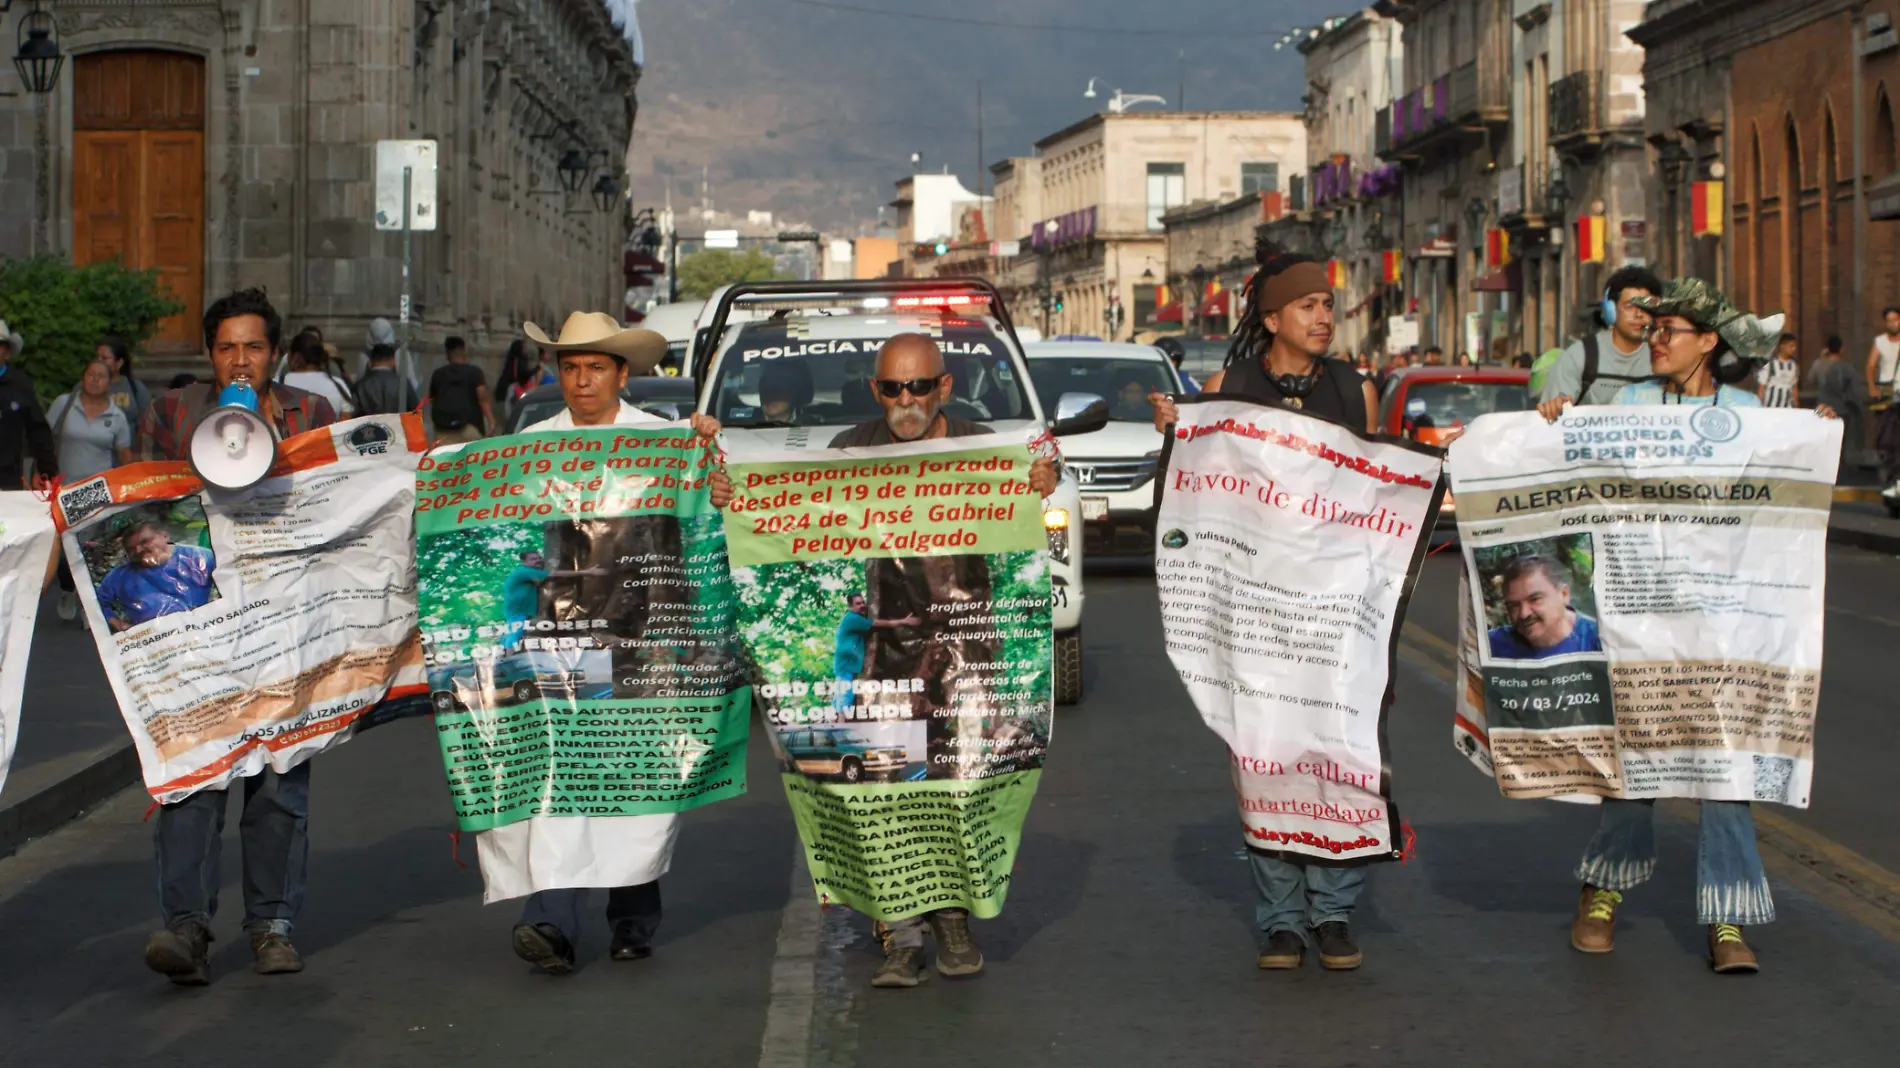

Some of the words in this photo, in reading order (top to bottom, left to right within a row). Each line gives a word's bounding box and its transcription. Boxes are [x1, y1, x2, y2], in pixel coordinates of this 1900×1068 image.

[743, 340, 857, 362] POLICÍA
[863, 341, 992, 355] MELIA
[1561, 412, 1654, 429] COMISIÓN
[1659, 415, 1683, 426] DE
[1563, 428, 1683, 446] BÚSQUEDA
[360, 446, 387, 456] FGE
[418, 437, 601, 472] Desaparición
[611, 435, 711, 453] forzada
[1565, 448, 1593, 462] DE
[1597, 444, 1714, 460] PERSONAS
[415, 469, 472, 493] esde
[482, 463, 508, 481] el
[519, 459, 552, 475] 19
[560, 456, 596, 473] de
[606, 456, 688, 471] marzo
[746, 461, 910, 488] Desaparición
[916, 456, 1014, 478] forzada
[416, 487, 481, 512] 2024
[490, 481, 526, 499] de
[539, 474, 603, 497] José
[730, 489, 808, 513] desde
[810, 484, 832, 506] el
[841, 483, 869, 502] 19
[876, 479, 906, 499] de
[914, 480, 991, 497] marzo
[1495, 484, 1593, 514] ALERTA
[1600, 483, 1634, 499] DE
[1641, 481, 1773, 501] BÚSQUEDA
[1174, 468, 1250, 494] Favor
[1257, 480, 1290, 509] de
[1301, 492, 1412, 538] difundir
[456, 500, 553, 524] Pelayo
[752, 512, 811, 535] 2024
[818, 509, 848, 529] de
[859, 504, 914, 530] José
[928, 502, 1015, 523] Gabriel
[1561, 513, 1589, 527] JOSÉ
[1591, 513, 1642, 524] GABRIEL
[1644, 513, 1688, 525] PELAYO
[1690, 515, 1742, 526] ZALGADO
[791, 533, 873, 555] Pelayo
[879, 528, 979, 553] Zalgado
[1195, 531, 1230, 545] Yulissa
[1230, 538, 1258, 556] Pelayo
[640, 565, 708, 574] ambiental
[711, 563, 725, 573] de
[1156, 558, 1167, 568] El
[1187, 560, 1202, 569] de
[1189, 575, 1203, 583] en
[1331, 604, 1350, 615] fue
[226, 599, 270, 621] SALGADO
[648, 602, 713, 611] Promotor
[984, 602, 993, 612] y
[995, 598, 1049, 610] defensor
[647, 615, 708, 625] procesos
[711, 613, 727, 623] de
[948, 612, 1012, 627] ambiental
[1013, 611, 1029, 623] de
[1274, 609, 1305, 622] hasta
[1307, 614, 1318, 624] el
[477, 618, 609, 638] EXPLORER
[1236, 617, 1255, 626] por
[1258, 618, 1269, 628] lo
[1271, 622, 1293, 634] cual
[513, 636, 594, 651] VERDE
[620, 639, 696, 649] ciudadana
[1243, 631, 1257, 641] de
[1259, 634, 1289, 647] redes
[1016, 659, 1032, 670] de
[1296, 653, 1303, 664] y
[1305, 655, 1339, 668] acceso
[1661, 666, 1672, 674] DE
[622, 677, 680, 688] Consejo
[684, 673, 733, 686] Popular
[812, 677, 925, 697] EXPLORER
[1491, 676, 1528, 688] Fecha
[1531, 676, 1548, 686] de
[1637, 676, 1661, 688] JOSÉ
[1663, 677, 1699, 687] GABRIEL
[1688, 689, 1702, 697] VEZ
[1278, 694, 1299, 704] nos
[1300, 698, 1334, 711] quieren
[1334, 701, 1360, 717] tener
[1501, 698, 1518, 710] 20
[1521, 697, 1529, 711] /
[1566, 692, 1600, 706] 2024
[522, 711, 534, 720] A
[535, 707, 574, 717] LAS
[577, 705, 723, 716] AUTORIDADES
[767, 707, 838, 724] COLOR
[842, 703, 914, 721] VERDE
[1000, 707, 1016, 717] en
[461, 719, 570, 740] INVESTIGAR
[576, 719, 619, 727] CON
[623, 716, 703, 726] MAYOR
[556, 729, 566, 737] Y
[571, 728, 688, 737] PRONTITUD
[691, 727, 719, 735] LA
[1630, 730, 1652, 738] TEME
[1656, 728, 1673, 737] POR
[454, 742, 550, 764] BÚSQUEDA
[554, 739, 670, 748] INMEDIATA
[1296, 759, 1374, 789] callar
[470, 785, 493, 795] SE
[495, 773, 599, 791] GARANTICE
[601, 778, 733, 802] LOCALIZACIÓN
[461, 797, 488, 807] LA
[490, 789, 528, 801] VIDA
[532, 785, 542, 793] Y
[565, 783, 600, 791] SUS
[603, 778, 706, 791] DERECHOS
[862, 793, 894, 803] LAS
[530, 806, 573, 814] CON
[577, 805, 626, 814] VIDA.
[898, 801, 935, 811] CON
[891, 847, 958, 863] PELAYO
[904, 870, 937, 885] SUS
[915, 884, 938, 895] SU
[882, 900, 918, 915] CON
